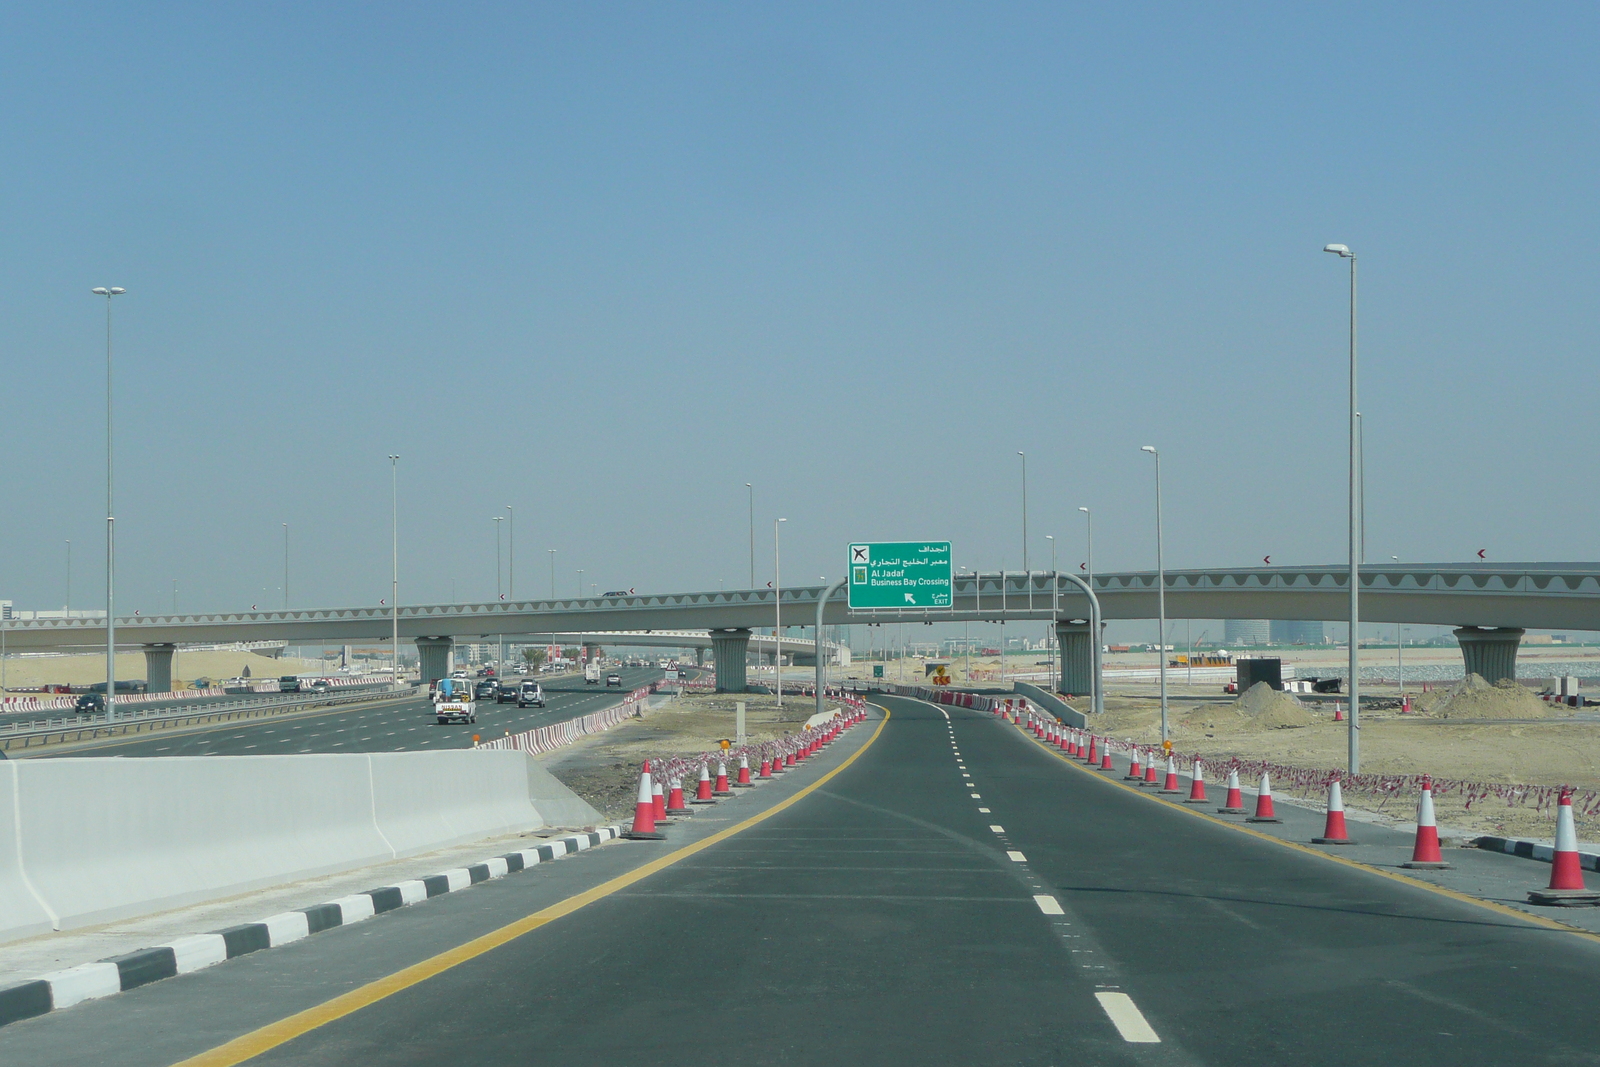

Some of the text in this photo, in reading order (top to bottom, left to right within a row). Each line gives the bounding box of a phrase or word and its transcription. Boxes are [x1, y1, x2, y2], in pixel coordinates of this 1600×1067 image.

[870, 558, 900, 567] التجاري
[902, 558, 928, 567] الخليج
[871, 578, 949, 587] Business Bay Crossing
